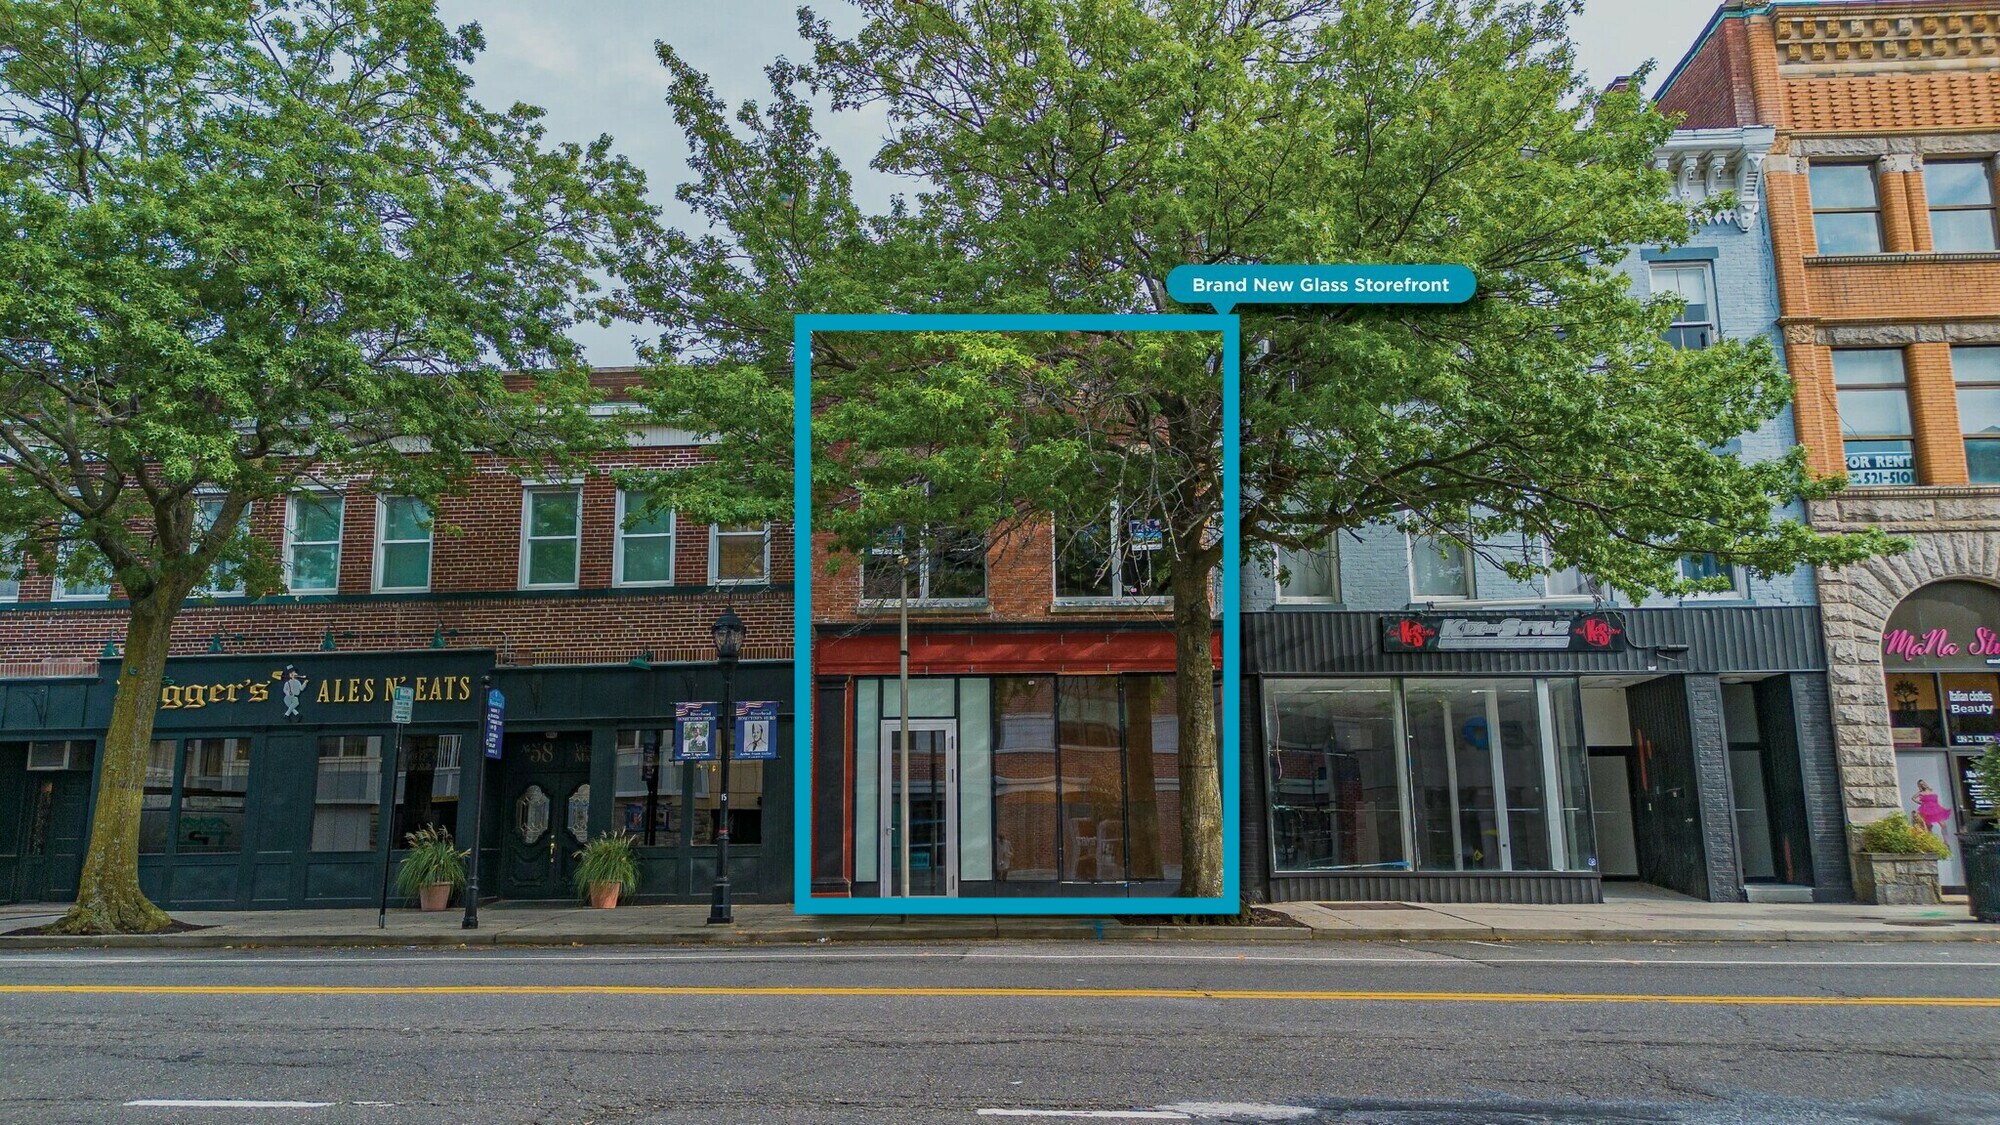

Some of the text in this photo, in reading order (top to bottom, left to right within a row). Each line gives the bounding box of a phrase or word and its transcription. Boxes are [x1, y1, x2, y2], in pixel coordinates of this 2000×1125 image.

[1875, 455, 1912, 468] RENT
[1883, 628, 1959, 661] MaNa
[316, 679, 375, 703] ALES
[415, 676, 470, 701] EATS
[1951, 703, 1993, 714] Beauty
[721, 793, 728, 801] 15
